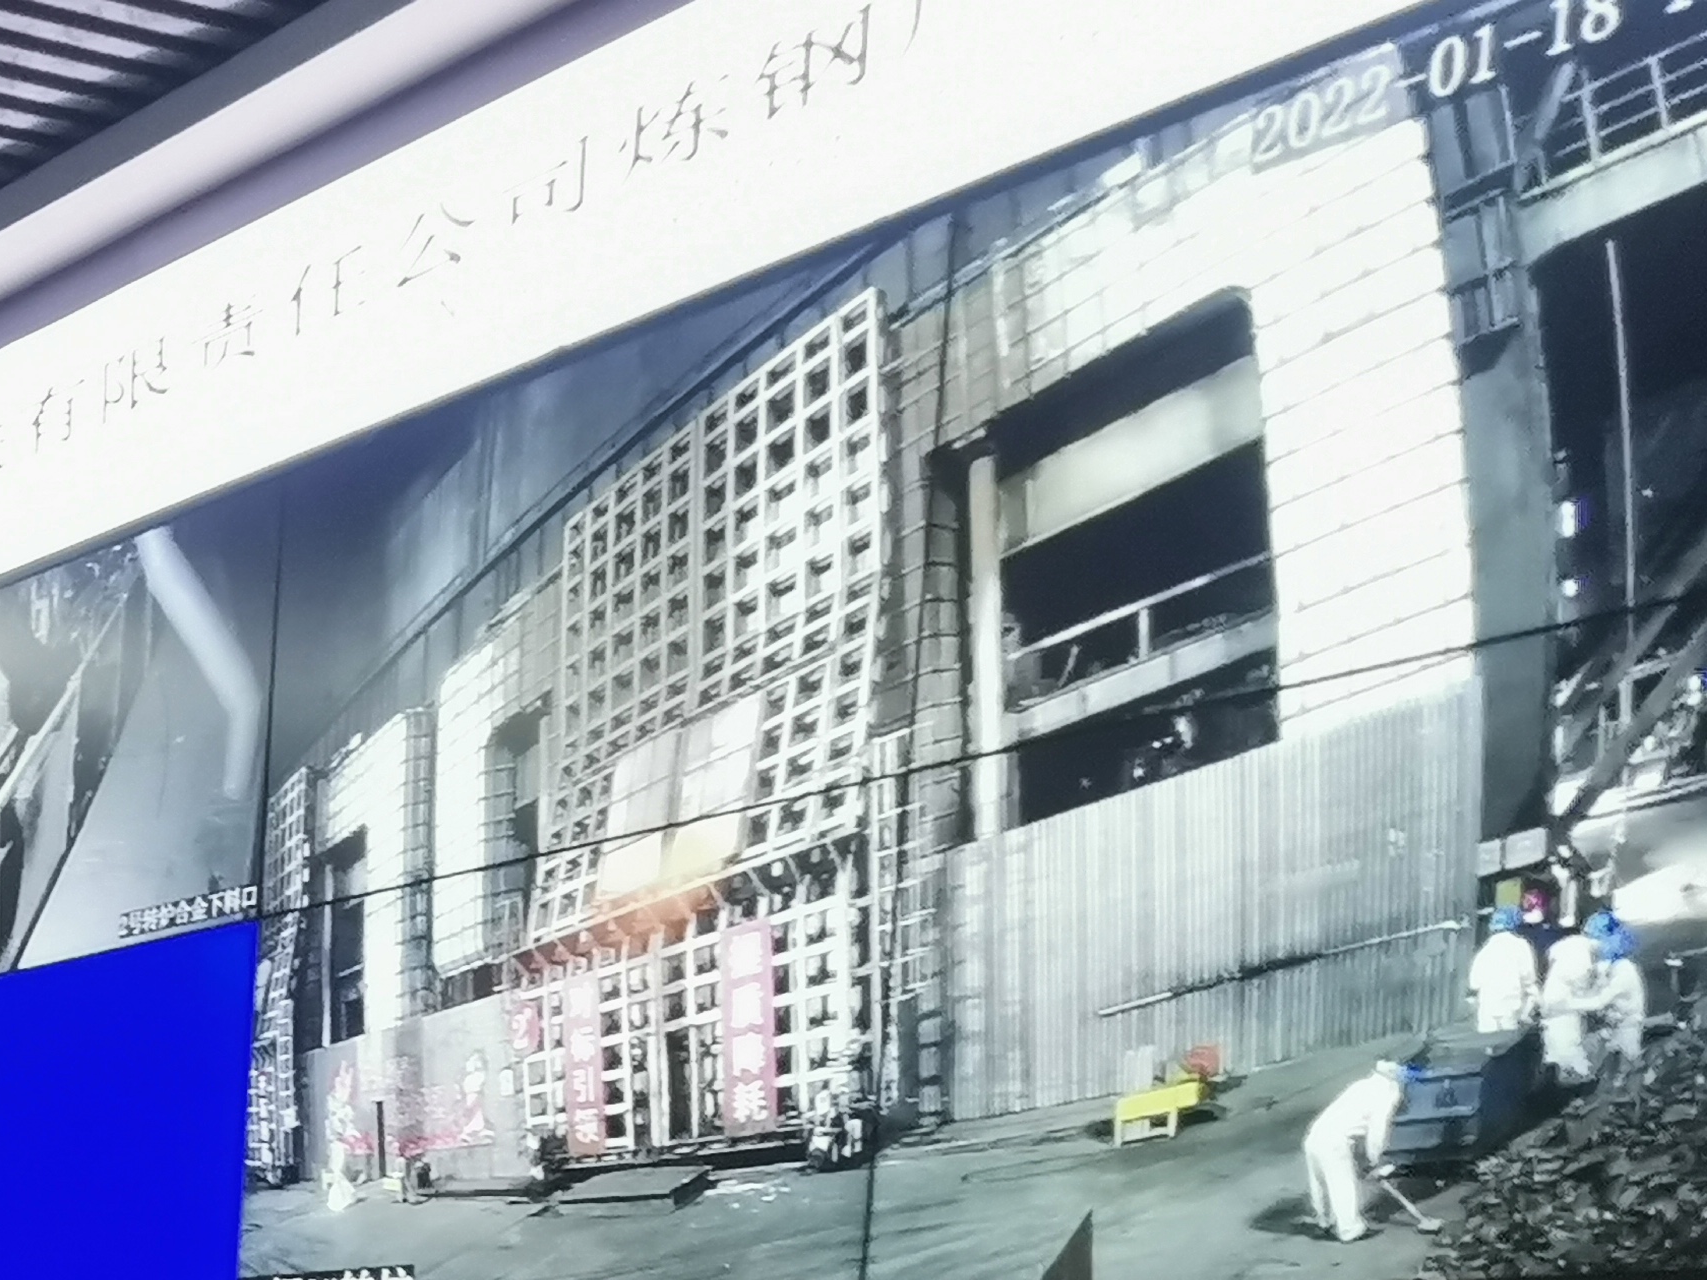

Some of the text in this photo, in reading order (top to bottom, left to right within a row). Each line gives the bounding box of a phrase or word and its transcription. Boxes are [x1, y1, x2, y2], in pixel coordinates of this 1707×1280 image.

[1250, 0, 1623, 164] 2022-01-18
[118, 885, 258, 937] 2号转炉合金下料口
